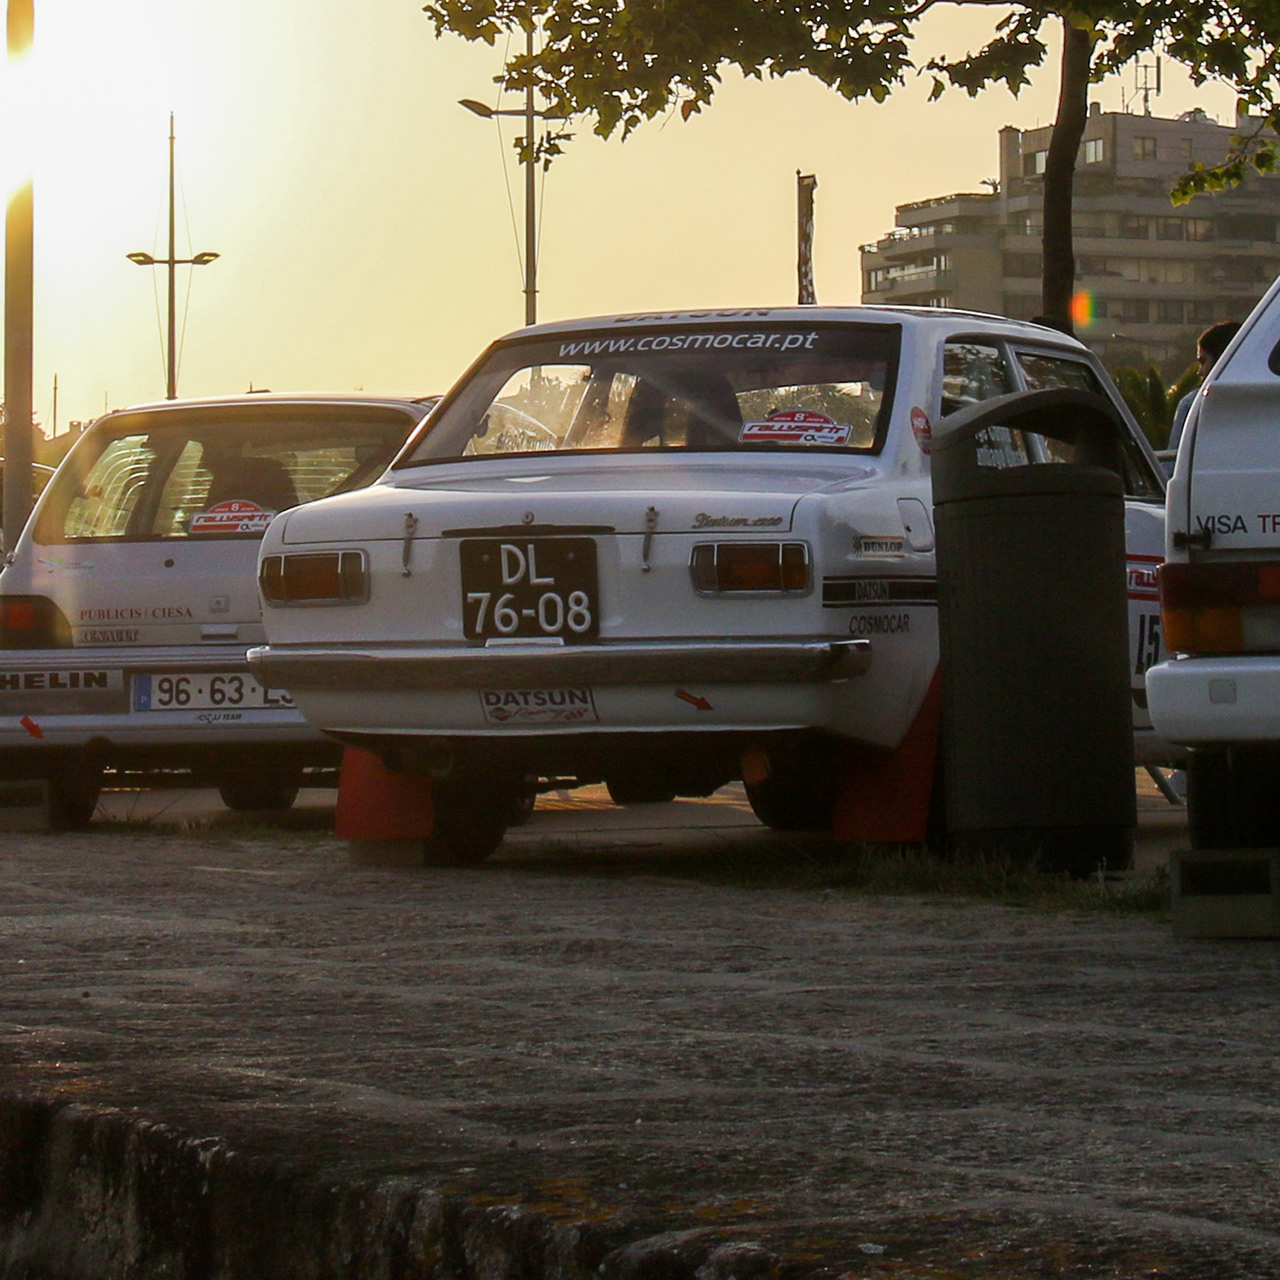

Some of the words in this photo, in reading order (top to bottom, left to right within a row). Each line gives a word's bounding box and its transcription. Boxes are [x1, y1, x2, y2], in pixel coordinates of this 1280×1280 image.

[558, 331, 819, 358] www.cosmocar.pt
[1195, 515, 1248, 534] VISA
[863, 541, 903, 552] DUNLOP
[501, 544, 555, 586] DL
[80, 608, 142, 621] PUBLICIS
[152, 607, 193, 619] CIESA
[467, 591, 591, 634] 76-08
[849, 614, 911, 634] COSMOCAR
[77, 630, 140, 643] RENAULT
[483, 690, 589, 707] DATSUN
